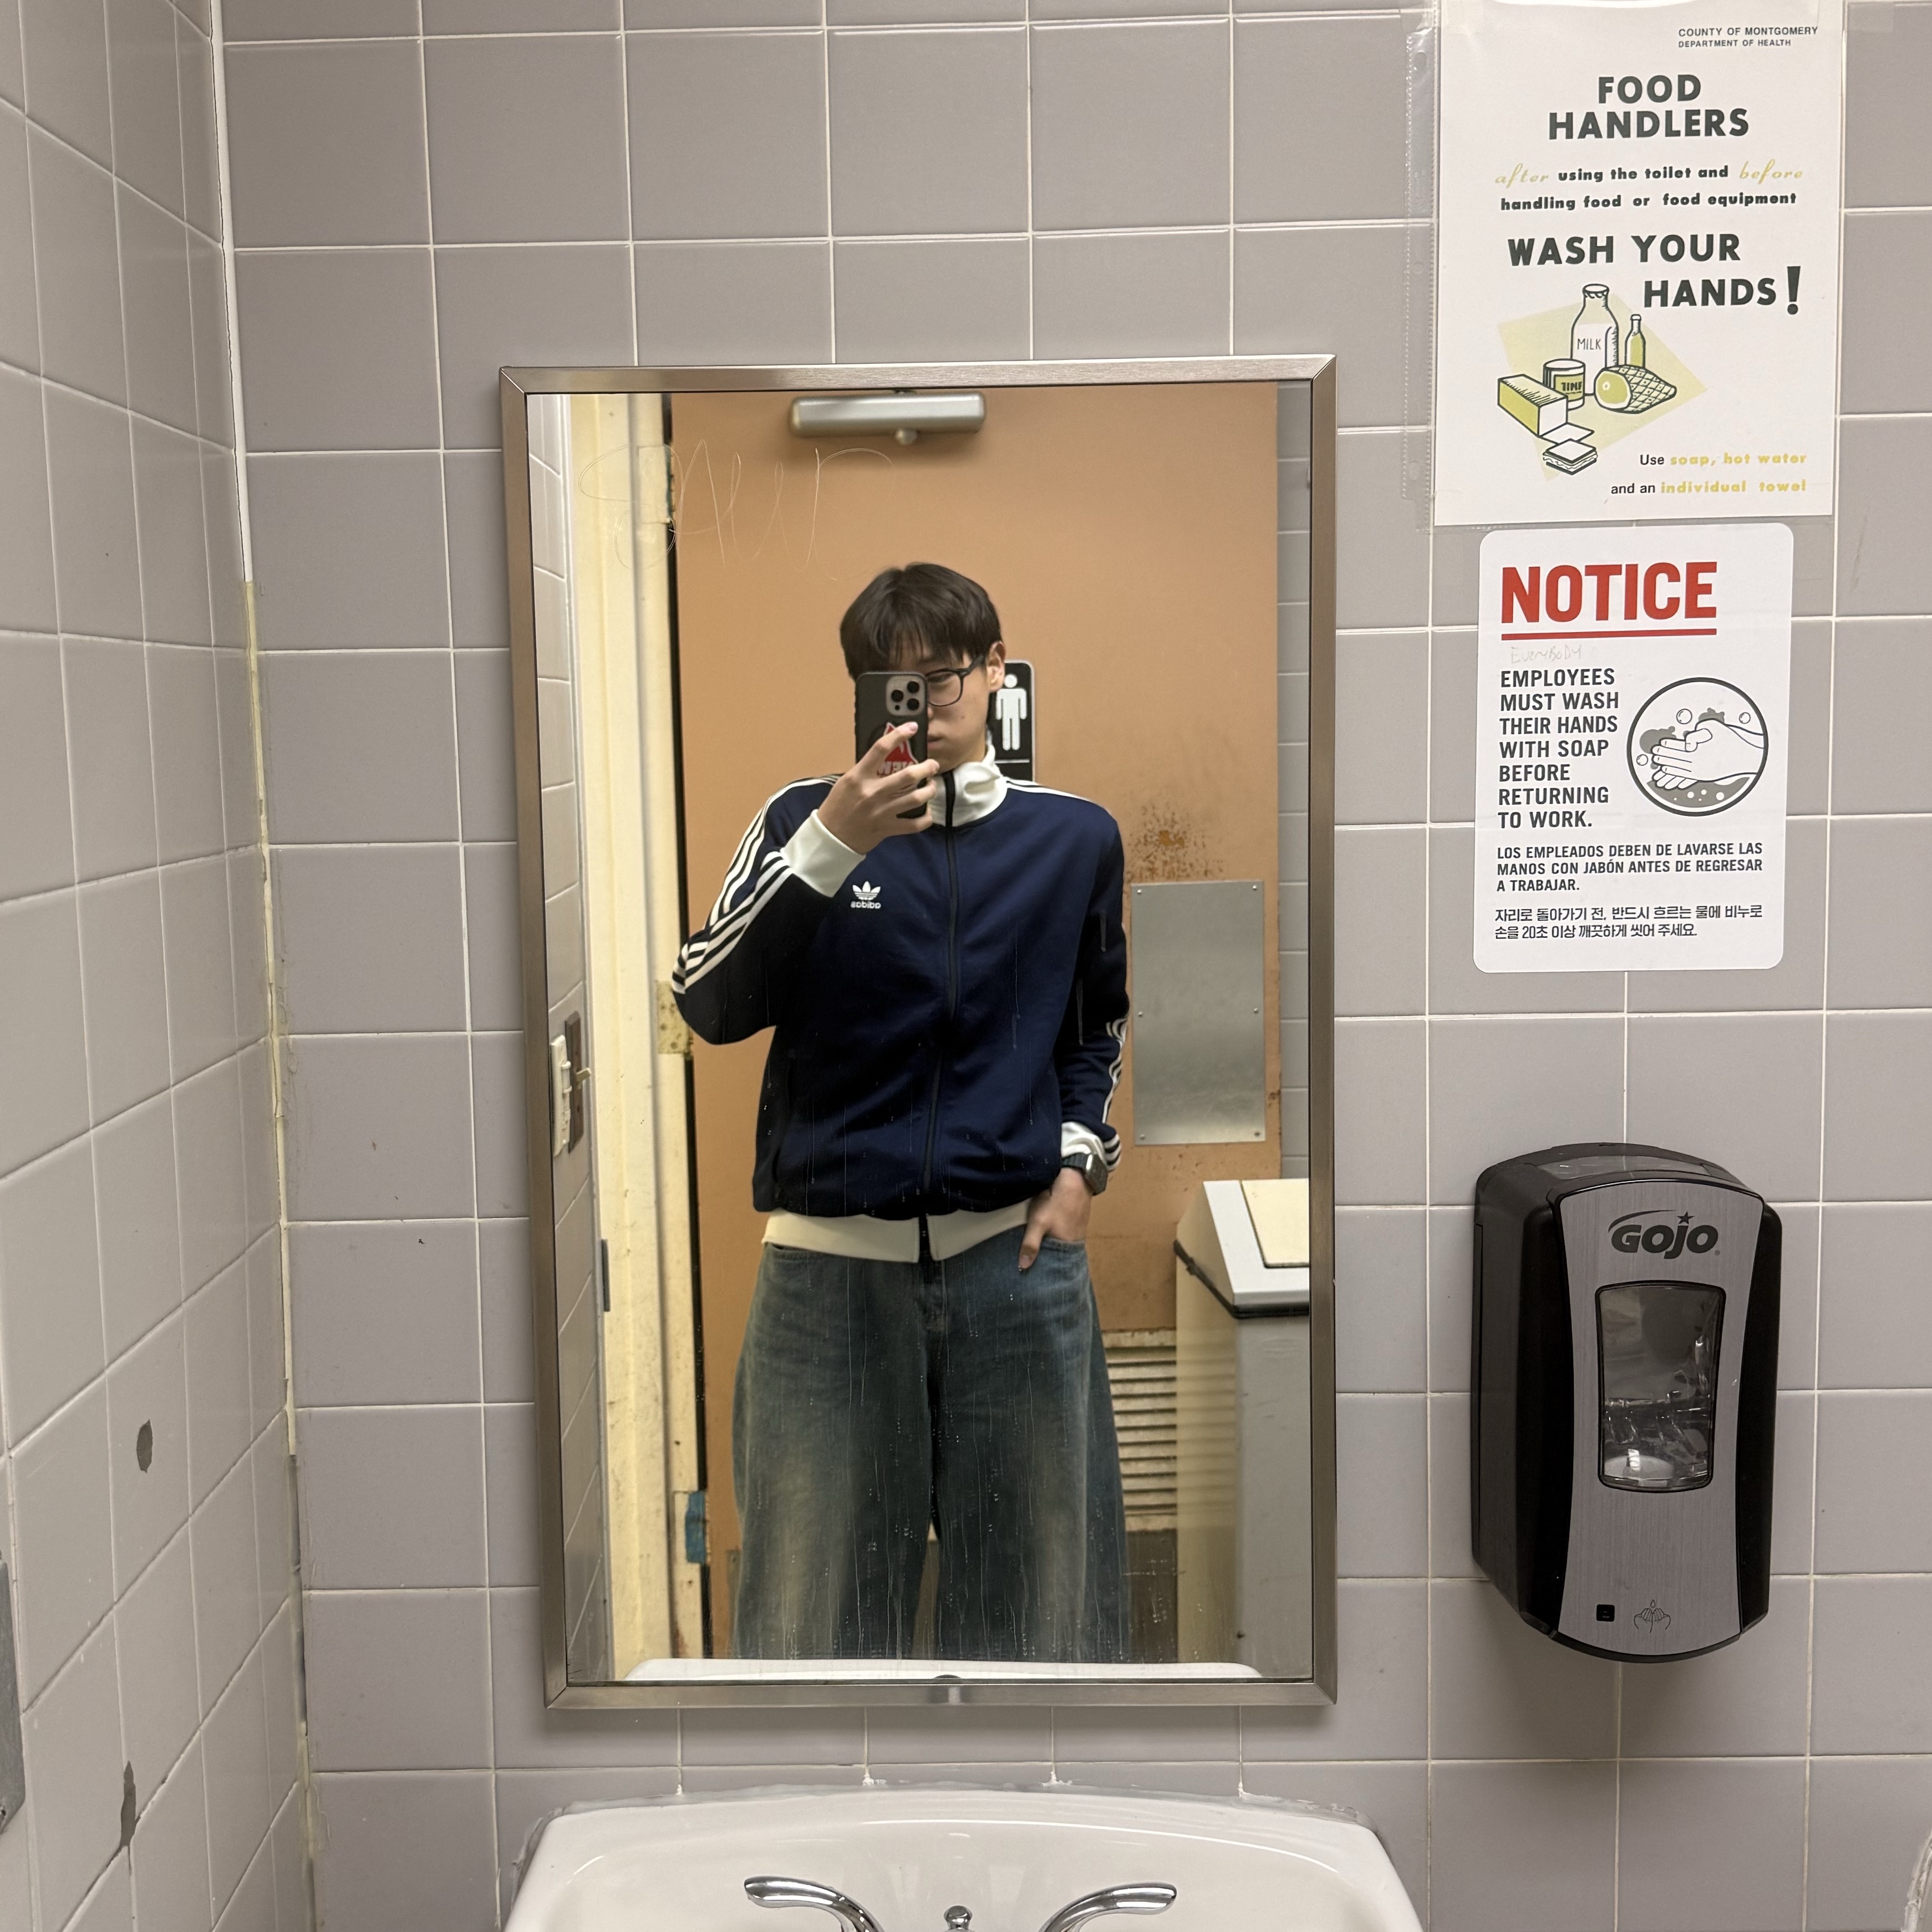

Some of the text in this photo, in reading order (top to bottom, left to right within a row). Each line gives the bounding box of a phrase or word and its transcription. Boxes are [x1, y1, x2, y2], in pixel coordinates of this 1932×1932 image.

[1678, 26, 1818, 37] COUNTY OF MONTGOMERY
[1678, 39, 1738, 48] DEPARTMENT
[1598, 74, 1701, 104] FOOD
[1549, 108, 1749, 140] HANDLERS
[1494, 159, 1803, 189] after using the toilet and before
[1501, 191, 1797, 211] handling food or food equipment
[1507, 233, 1741, 267] WASH YOUR
[1577, 338, 1601, 350] MILK
[1640, 452, 1806, 467] Use soap, hot water
[1611, 479, 1806, 495] and an individual towel
[1502, 562, 1717, 623] NOTICE
[1501, 668, 1615, 688] EMPLOYEES
[1501, 692, 1619, 711] MUST WASH
[1499, 715, 1618, 735] THEIR HANDS
[1499, 739, 1609, 759] WITH SOAP
[1499, 764, 1570, 782] BEFORE
[1498, 786, 1609, 806] RETURNING
[1497, 810, 1592, 829] TO WORK.
[1497, 842, 1763, 859] LOS EMPLEADOS DEBEN DE LAVARSE LAS
[1497, 858, 1762, 876] MANOS CON JABÓN ANTES DE REGRESAR
[1496, 878, 1580, 892] A TRABAJAR.
[1495, 904, 1763, 922] 자리로 돌아가기 전, 반드시 흐르는 물에 비누로
[1494, 923, 1697, 939] 손을 20초 이상 깨끗하게 씻어 주세요.
